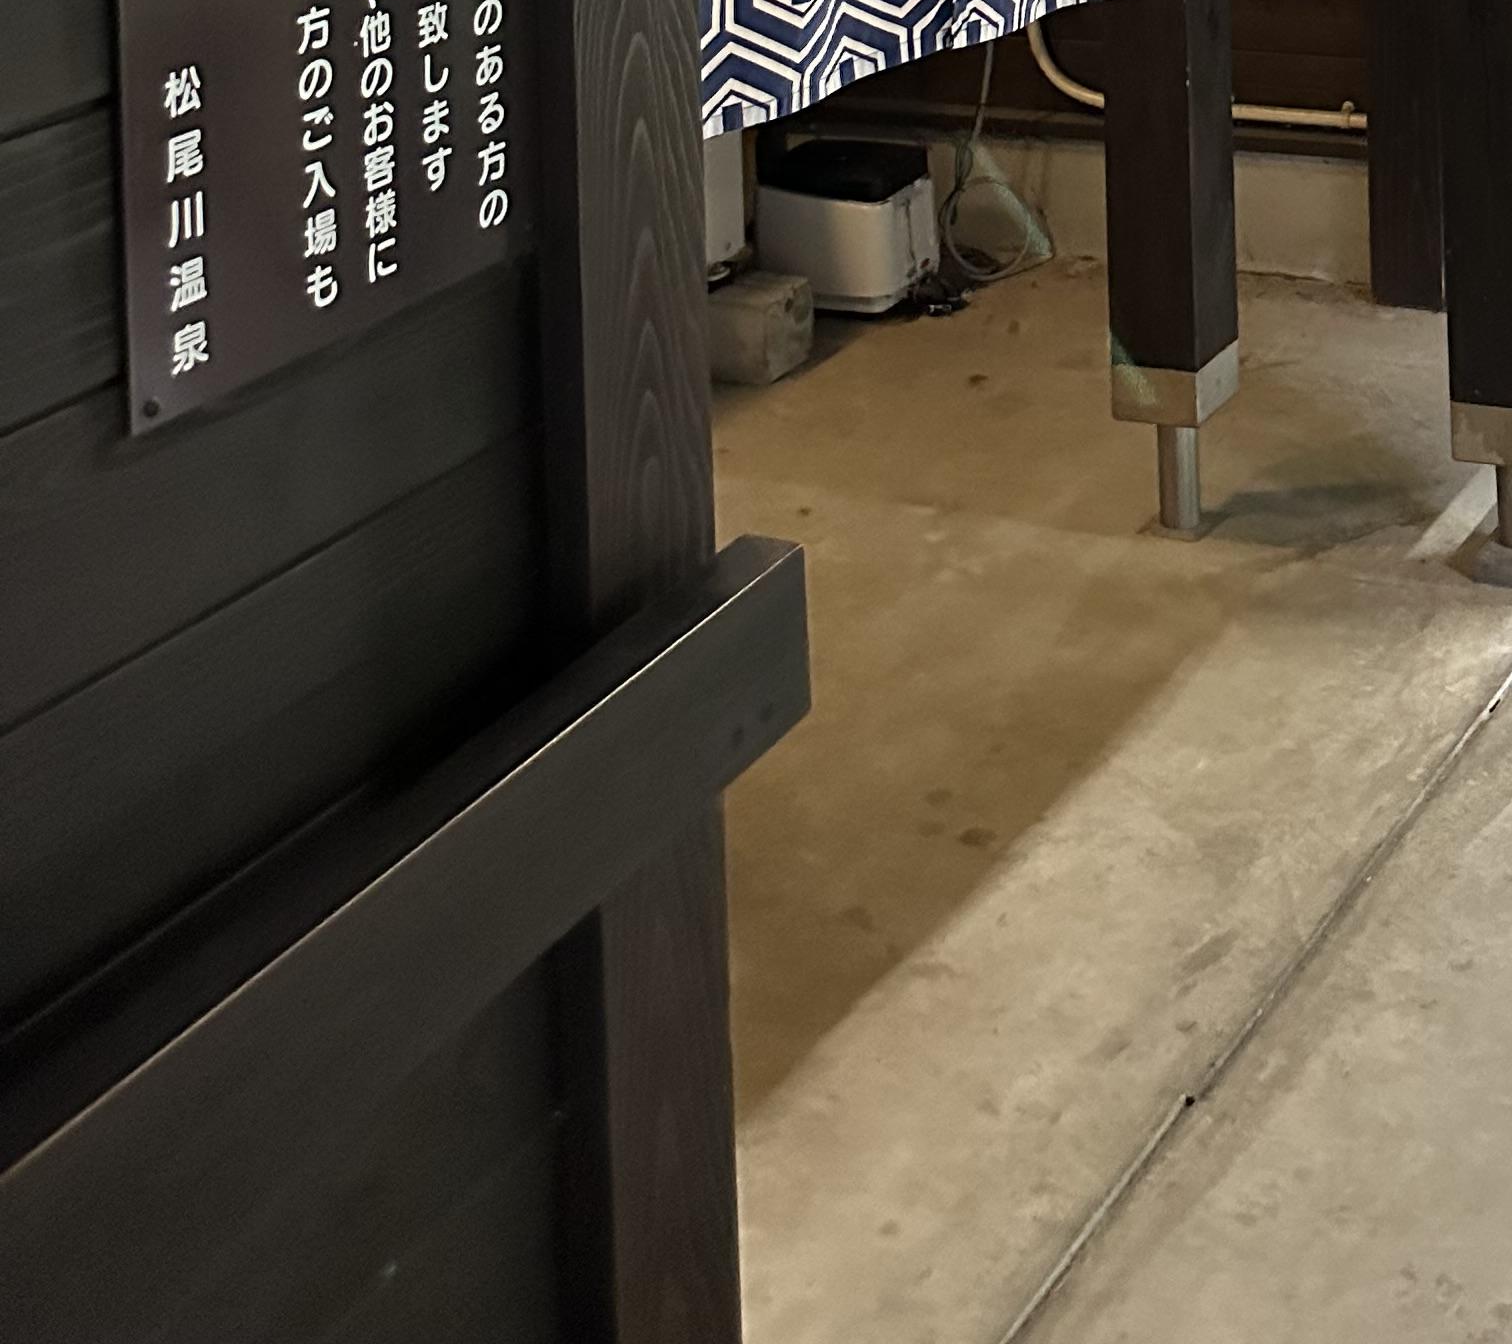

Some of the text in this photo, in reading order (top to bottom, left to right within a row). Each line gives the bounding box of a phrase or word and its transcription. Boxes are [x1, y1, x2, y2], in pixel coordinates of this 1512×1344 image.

[164, 66, 209, 375] 松尾川温泉
